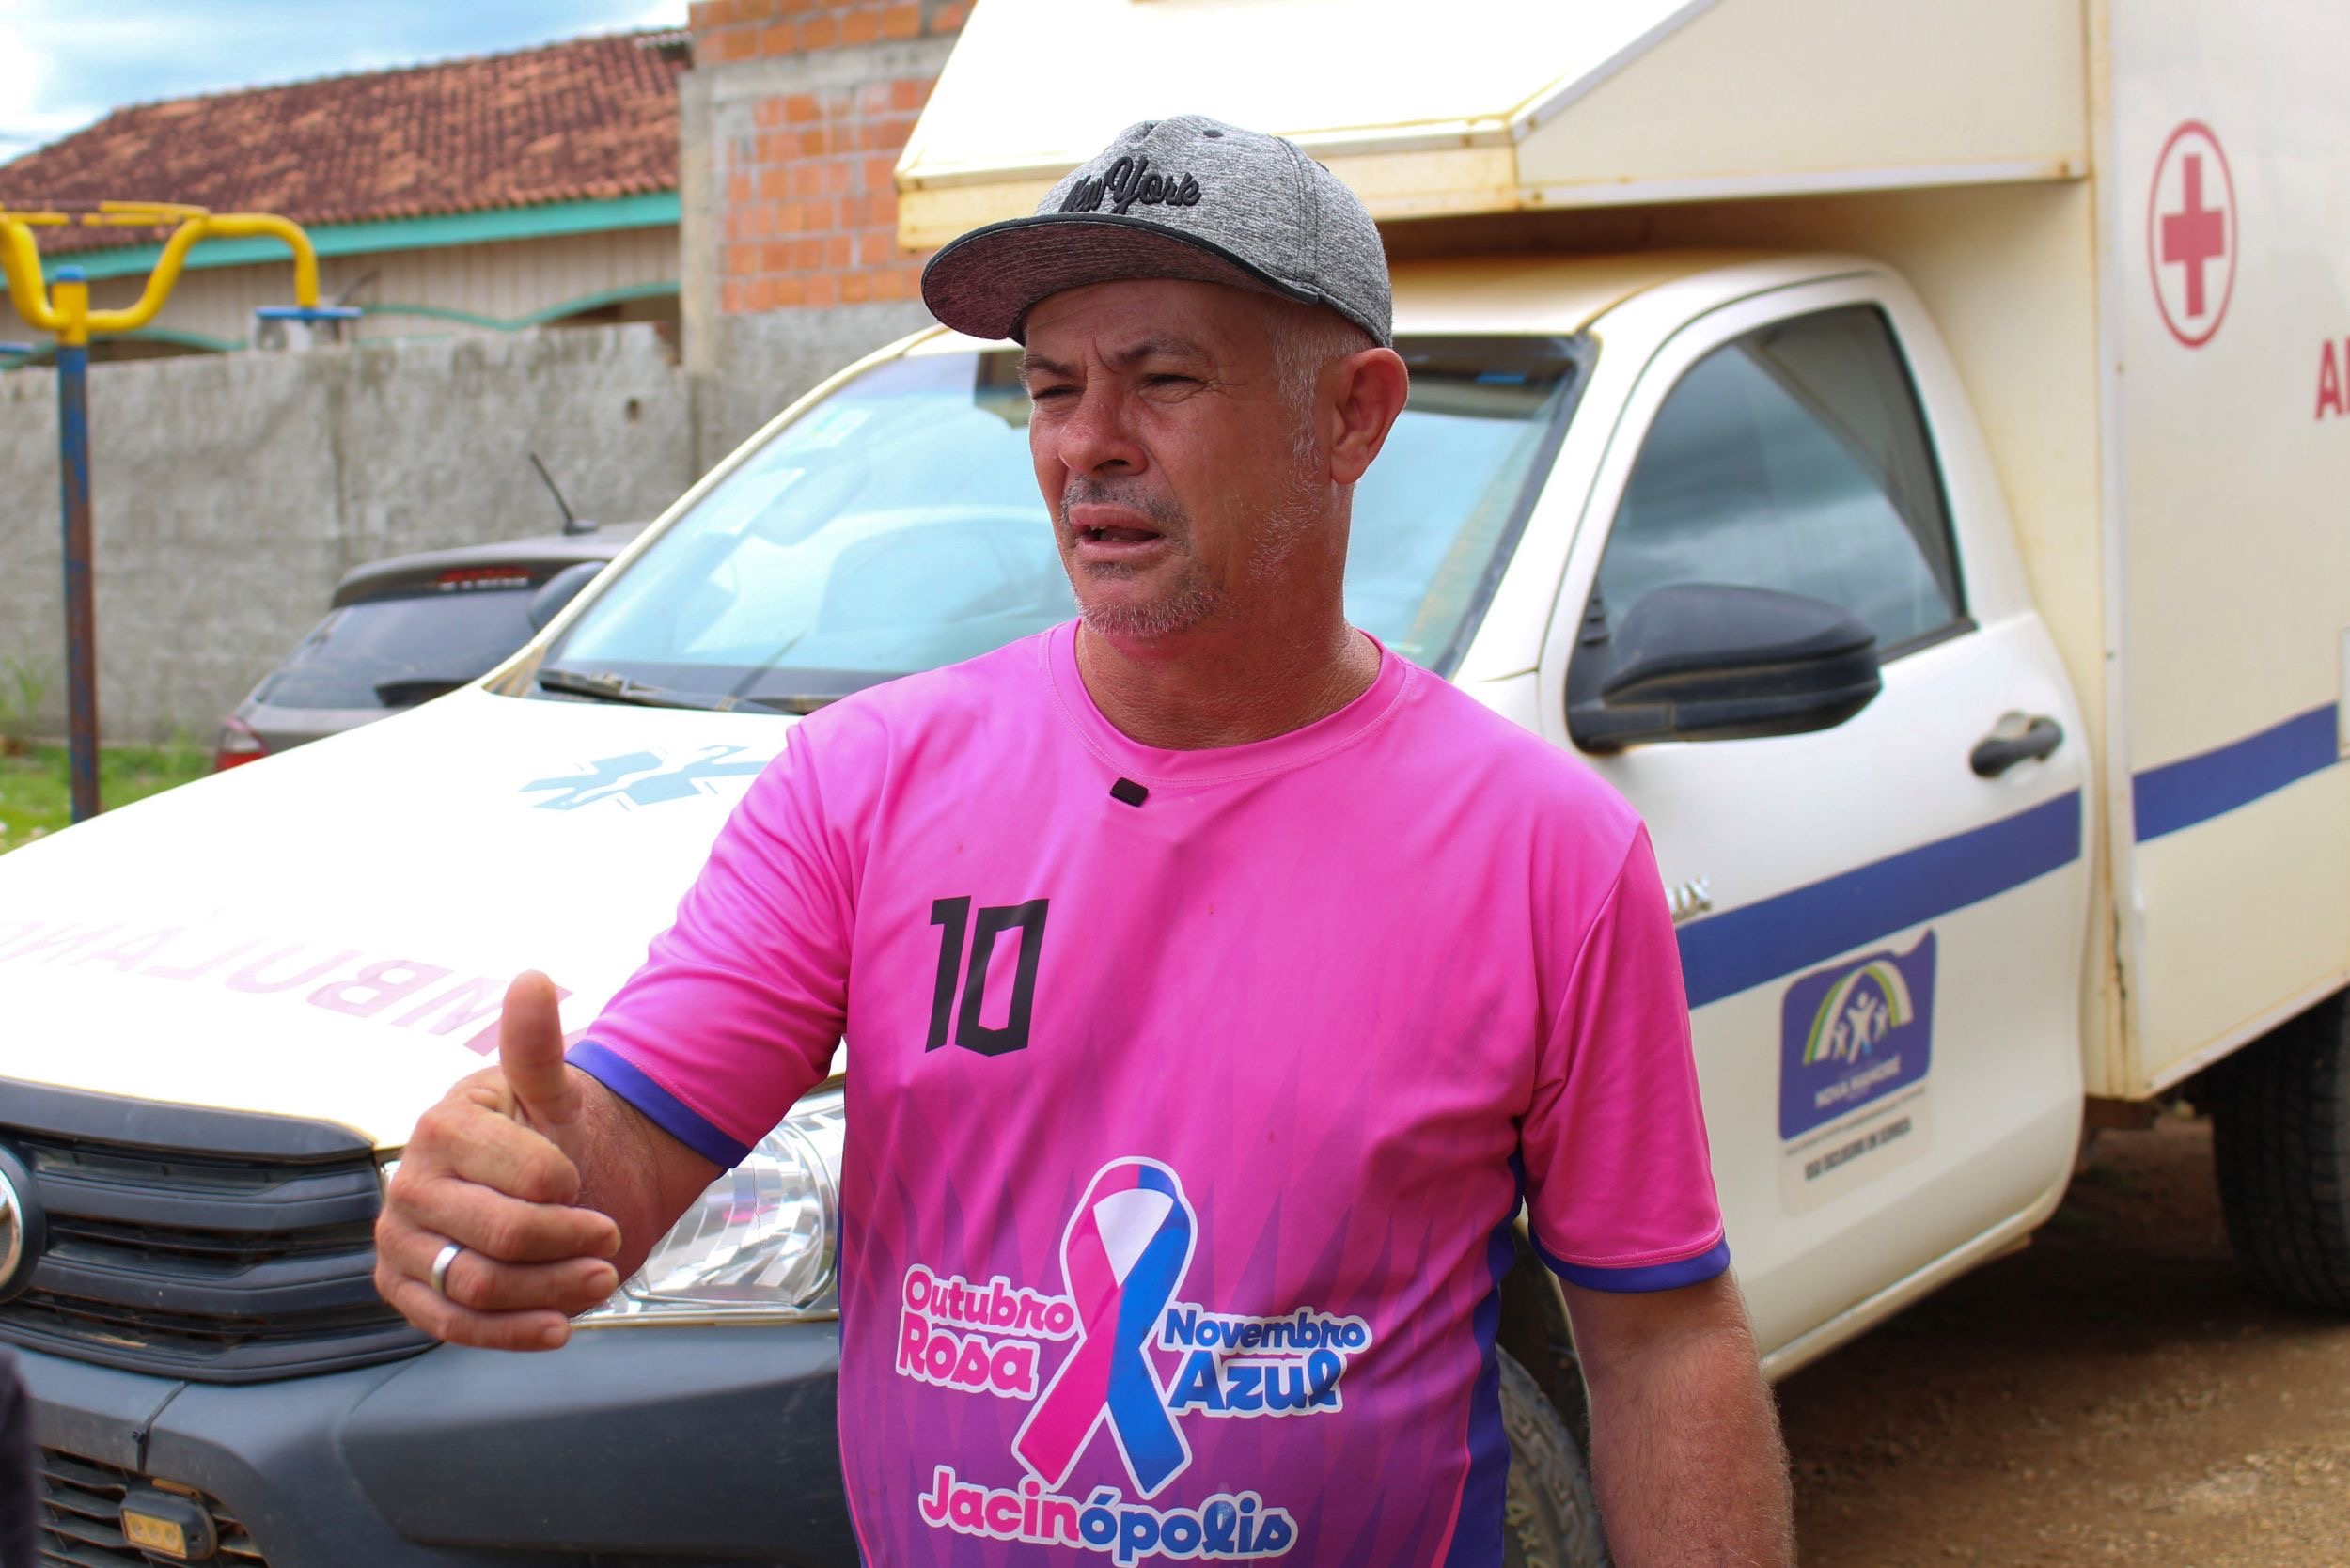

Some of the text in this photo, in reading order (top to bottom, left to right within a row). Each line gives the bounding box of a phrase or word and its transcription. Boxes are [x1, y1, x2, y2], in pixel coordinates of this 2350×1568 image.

[1104, 155, 1202, 214] York
[925, 895, 1049, 1057] 10
[904, 1267, 1075, 1336] Outubro
[1164, 1308, 1367, 1350] Novembro
[899, 1310, 1034, 1394] Rosa
[1167, 1348, 1343, 1411] Azul
[921, 1470, 1293, 1563] Jacinópolis
